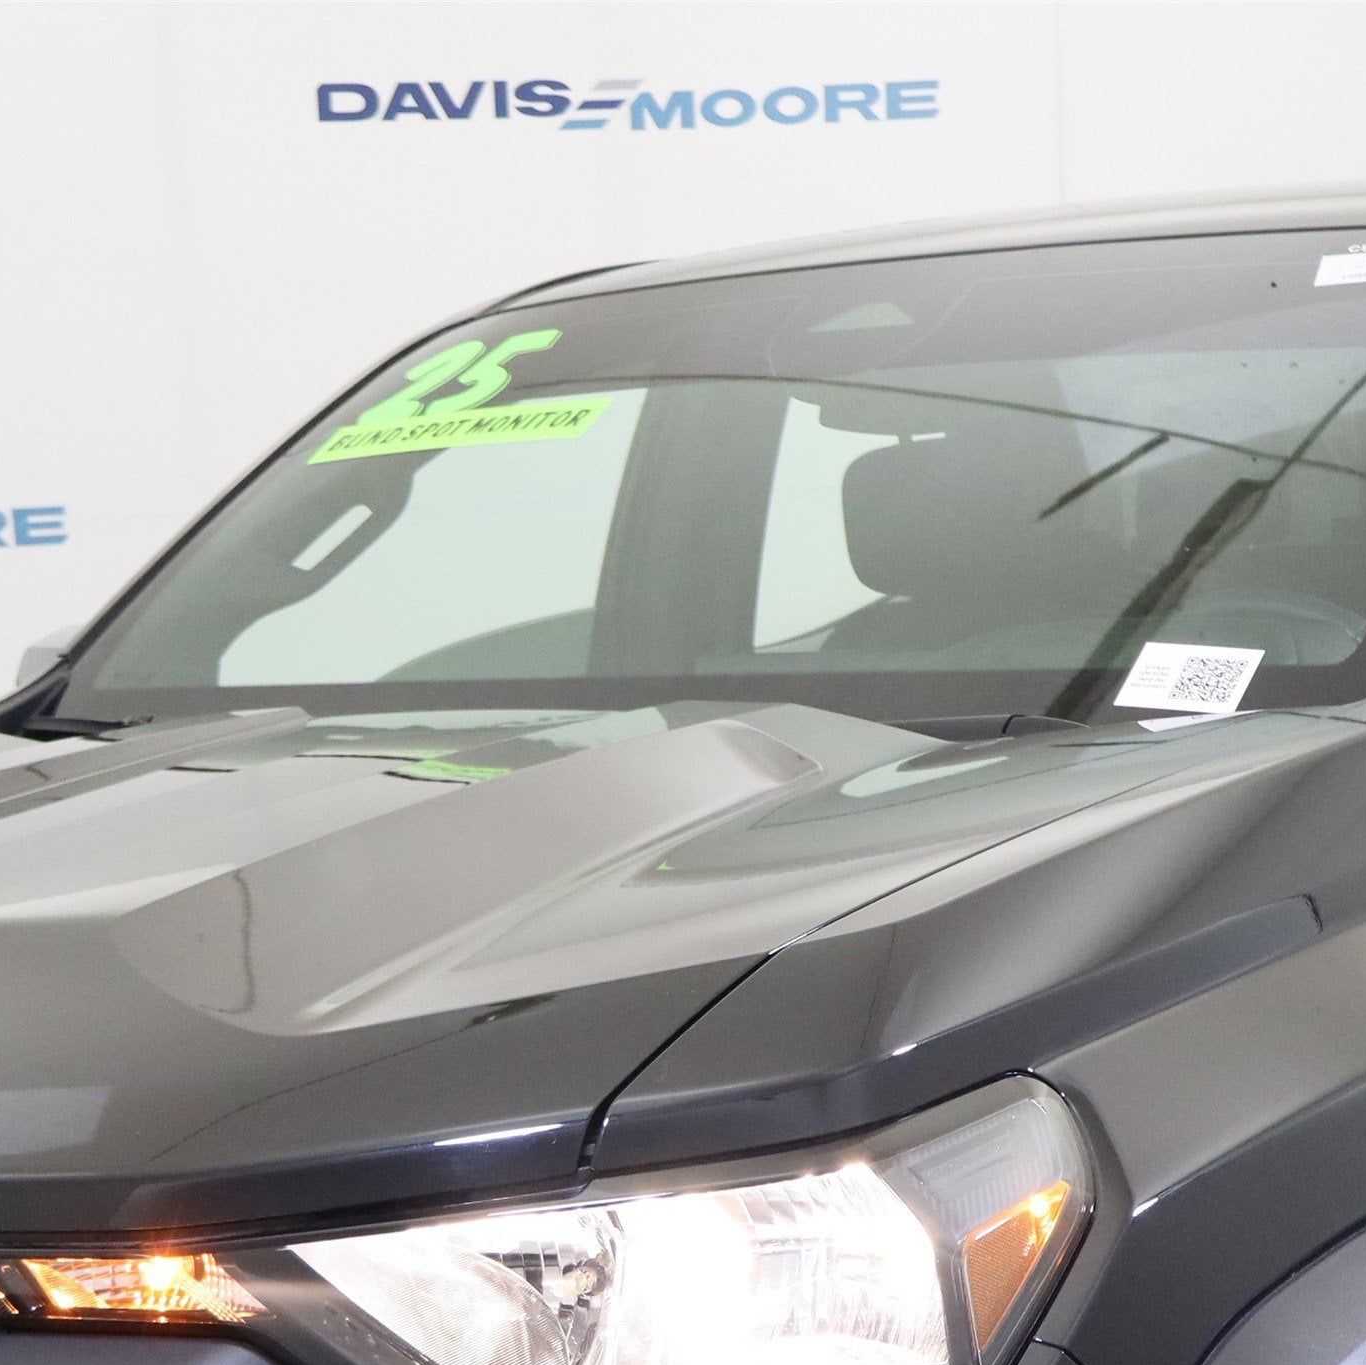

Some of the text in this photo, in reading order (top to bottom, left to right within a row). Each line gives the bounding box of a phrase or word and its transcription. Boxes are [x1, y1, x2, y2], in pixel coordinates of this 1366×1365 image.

[316, 79, 941, 131] DAVIS MOORE
[356, 328, 563, 426] 25
[327, 409, 592, 451] BLIND SPOT MONITOR
